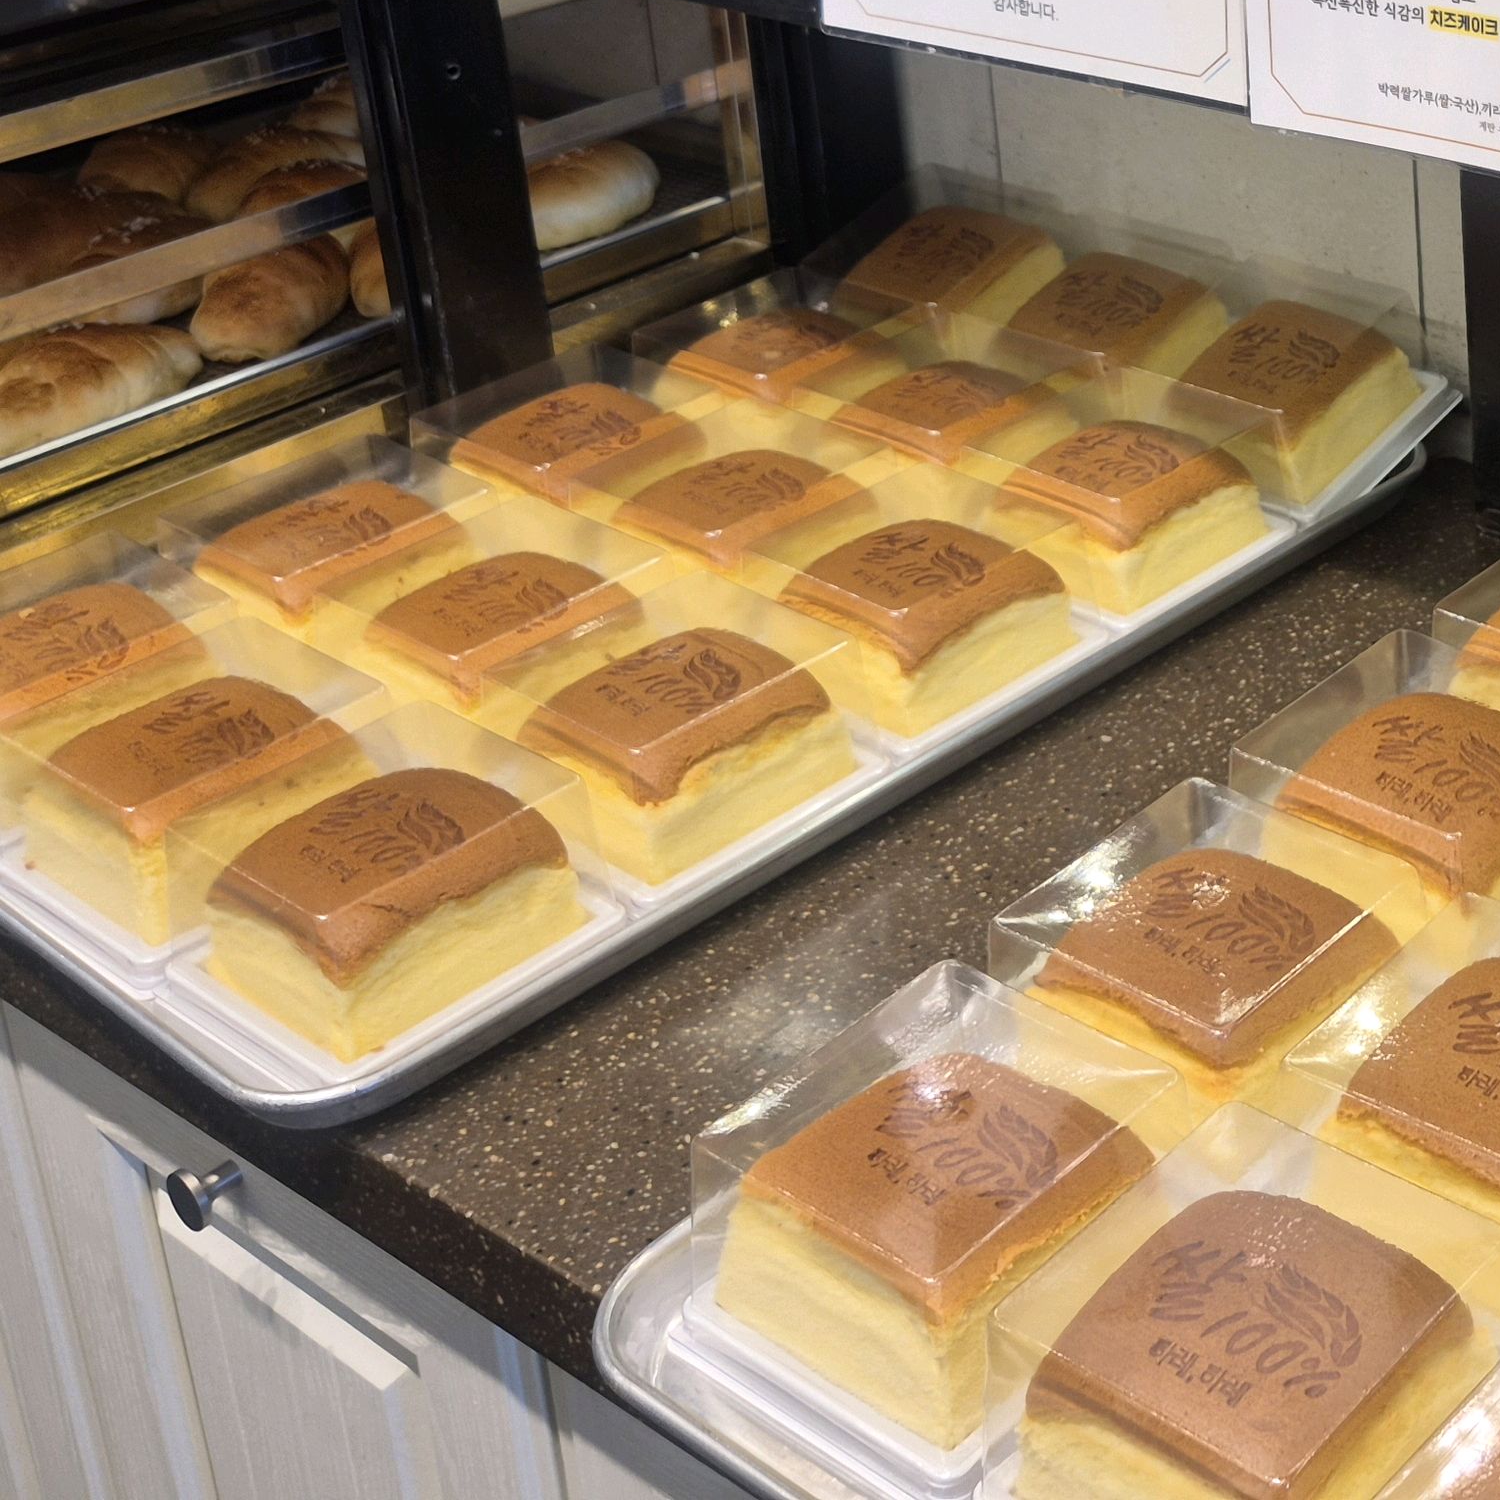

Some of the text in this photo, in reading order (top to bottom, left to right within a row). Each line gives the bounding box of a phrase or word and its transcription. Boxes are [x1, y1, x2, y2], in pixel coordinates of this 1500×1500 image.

[1383, 1, 1425, 25] 식감의
[1429, 9, 1499, 38] 치즈케이크
[1149, 1241, 1341, 1399] 쌀 100%
